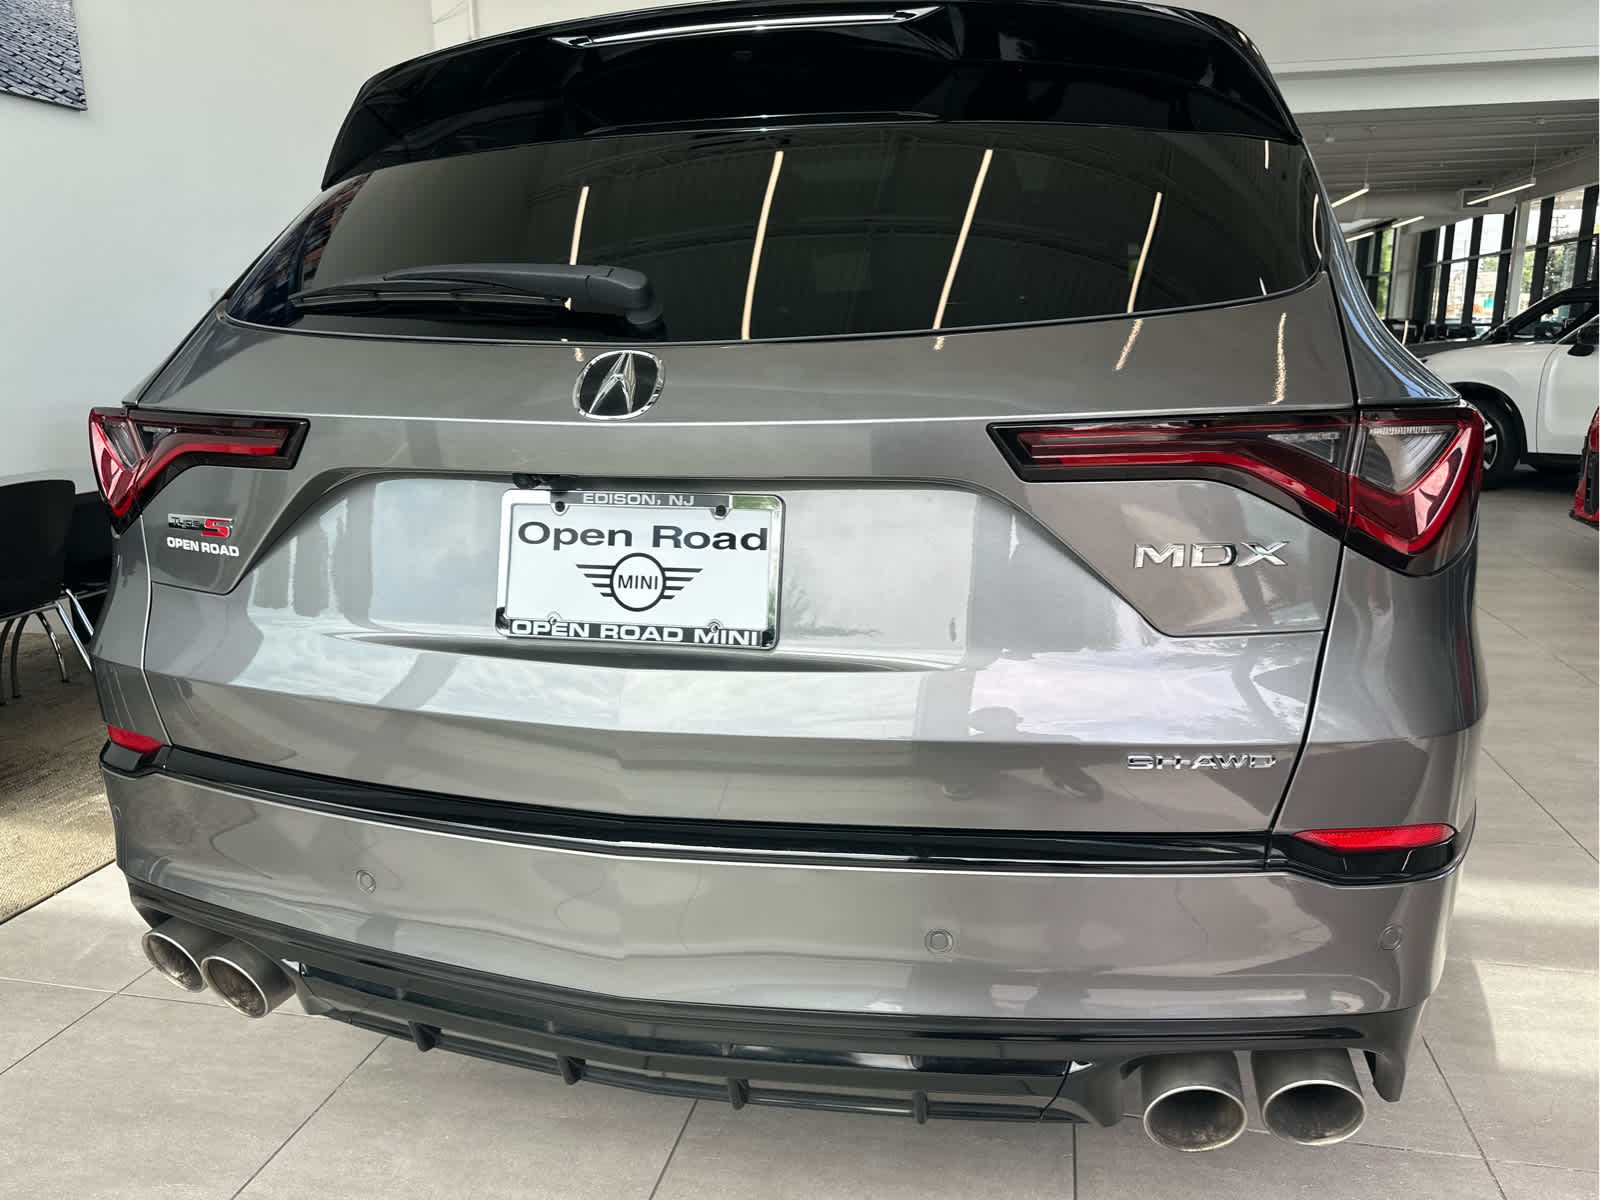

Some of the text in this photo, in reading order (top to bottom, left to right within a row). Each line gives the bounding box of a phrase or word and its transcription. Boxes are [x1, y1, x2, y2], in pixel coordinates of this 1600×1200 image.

[583, 493, 695, 507] EDISON, NJ
[201, 518, 232, 538] S
[518, 521, 768, 551] Open Road
[166, 536, 240, 557] OPEN ROAD
[1134, 541, 1289, 568] MDX
[617, 575, 659, 591] MINI
[511, 620, 758, 647] OPEN ROAD MINI
[1127, 753, 1277, 770] SH-AWD
